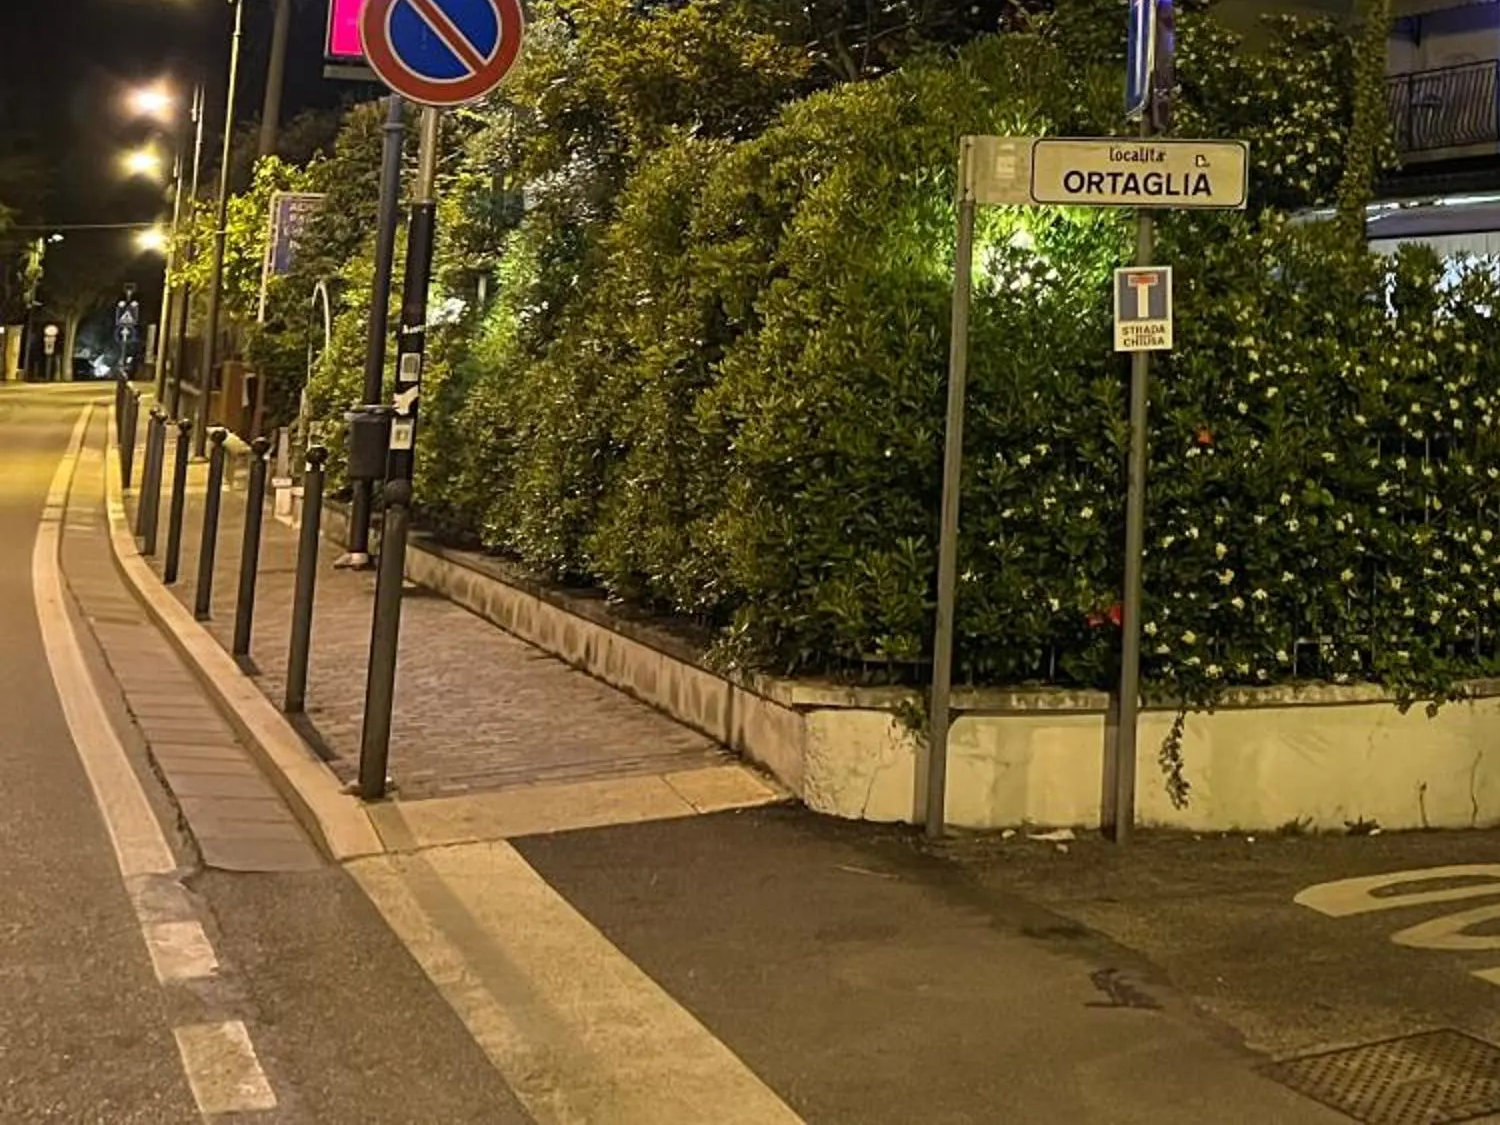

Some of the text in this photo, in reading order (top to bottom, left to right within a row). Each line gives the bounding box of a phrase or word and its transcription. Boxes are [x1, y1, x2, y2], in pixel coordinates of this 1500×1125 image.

[1063, 170, 1212, 197] ORTAGLIA
[1121, 324, 1166, 336] STRADA
[1122, 336, 1165, 348] CHIUSA
